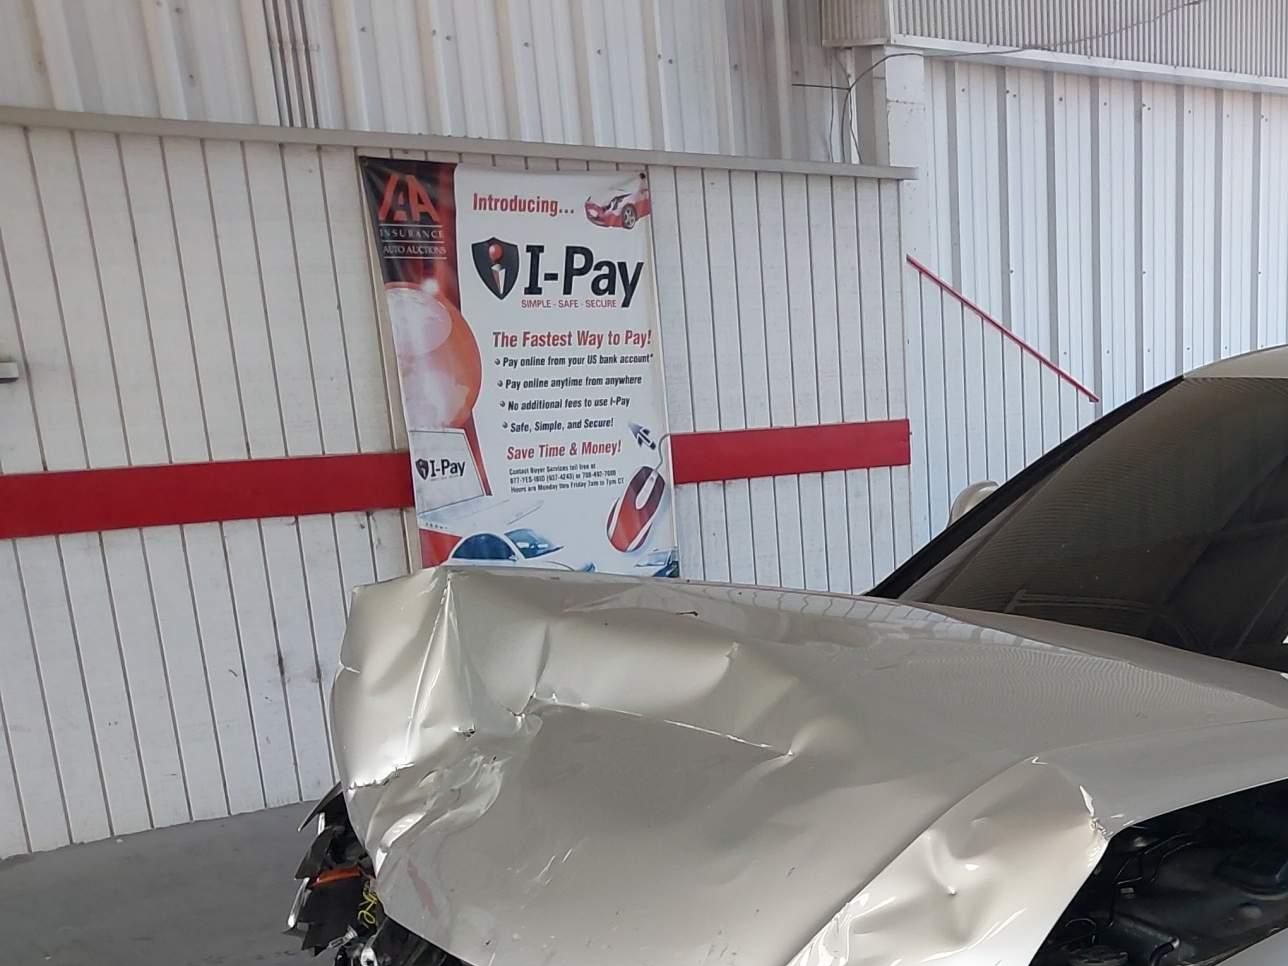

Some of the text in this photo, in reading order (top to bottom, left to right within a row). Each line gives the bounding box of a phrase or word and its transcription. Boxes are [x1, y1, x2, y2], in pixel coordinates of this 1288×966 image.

[472, 192, 575, 217] Introducing...
[380, 228, 444, 239] INSURANCE
[383, 245, 447, 255] AUTO AUCTIONS
[524, 244, 645, 309] I-Pay
[521, 299, 551, 308] SIMPLE
[558, 299, 579, 308] SAFE
[585, 299, 617, 308] SECURE
[493, 329, 652, 349] The Fastest Way to Pay!
[503, 357, 518, 368] Pay
[520, 356, 545, 366] online
[548, 355, 566, 366] from
[568, 356, 585, 367] your
[587, 355, 597, 364] US
[600, 354, 617, 364] bank
[505, 375, 642, 390] Pay online anytime from anywhere
[508, 400, 519, 411] No
[521, 399, 562, 410] additional
[565, 398, 582, 408] fees
[584, 397, 592, 407] to
[594, 398, 608, 407] use
[510, 417, 614, 433] Safe, Simple, and Secure!
[507, 440, 622, 461] Save Time & Money!
[430, 458, 466, 477] I-Pay
